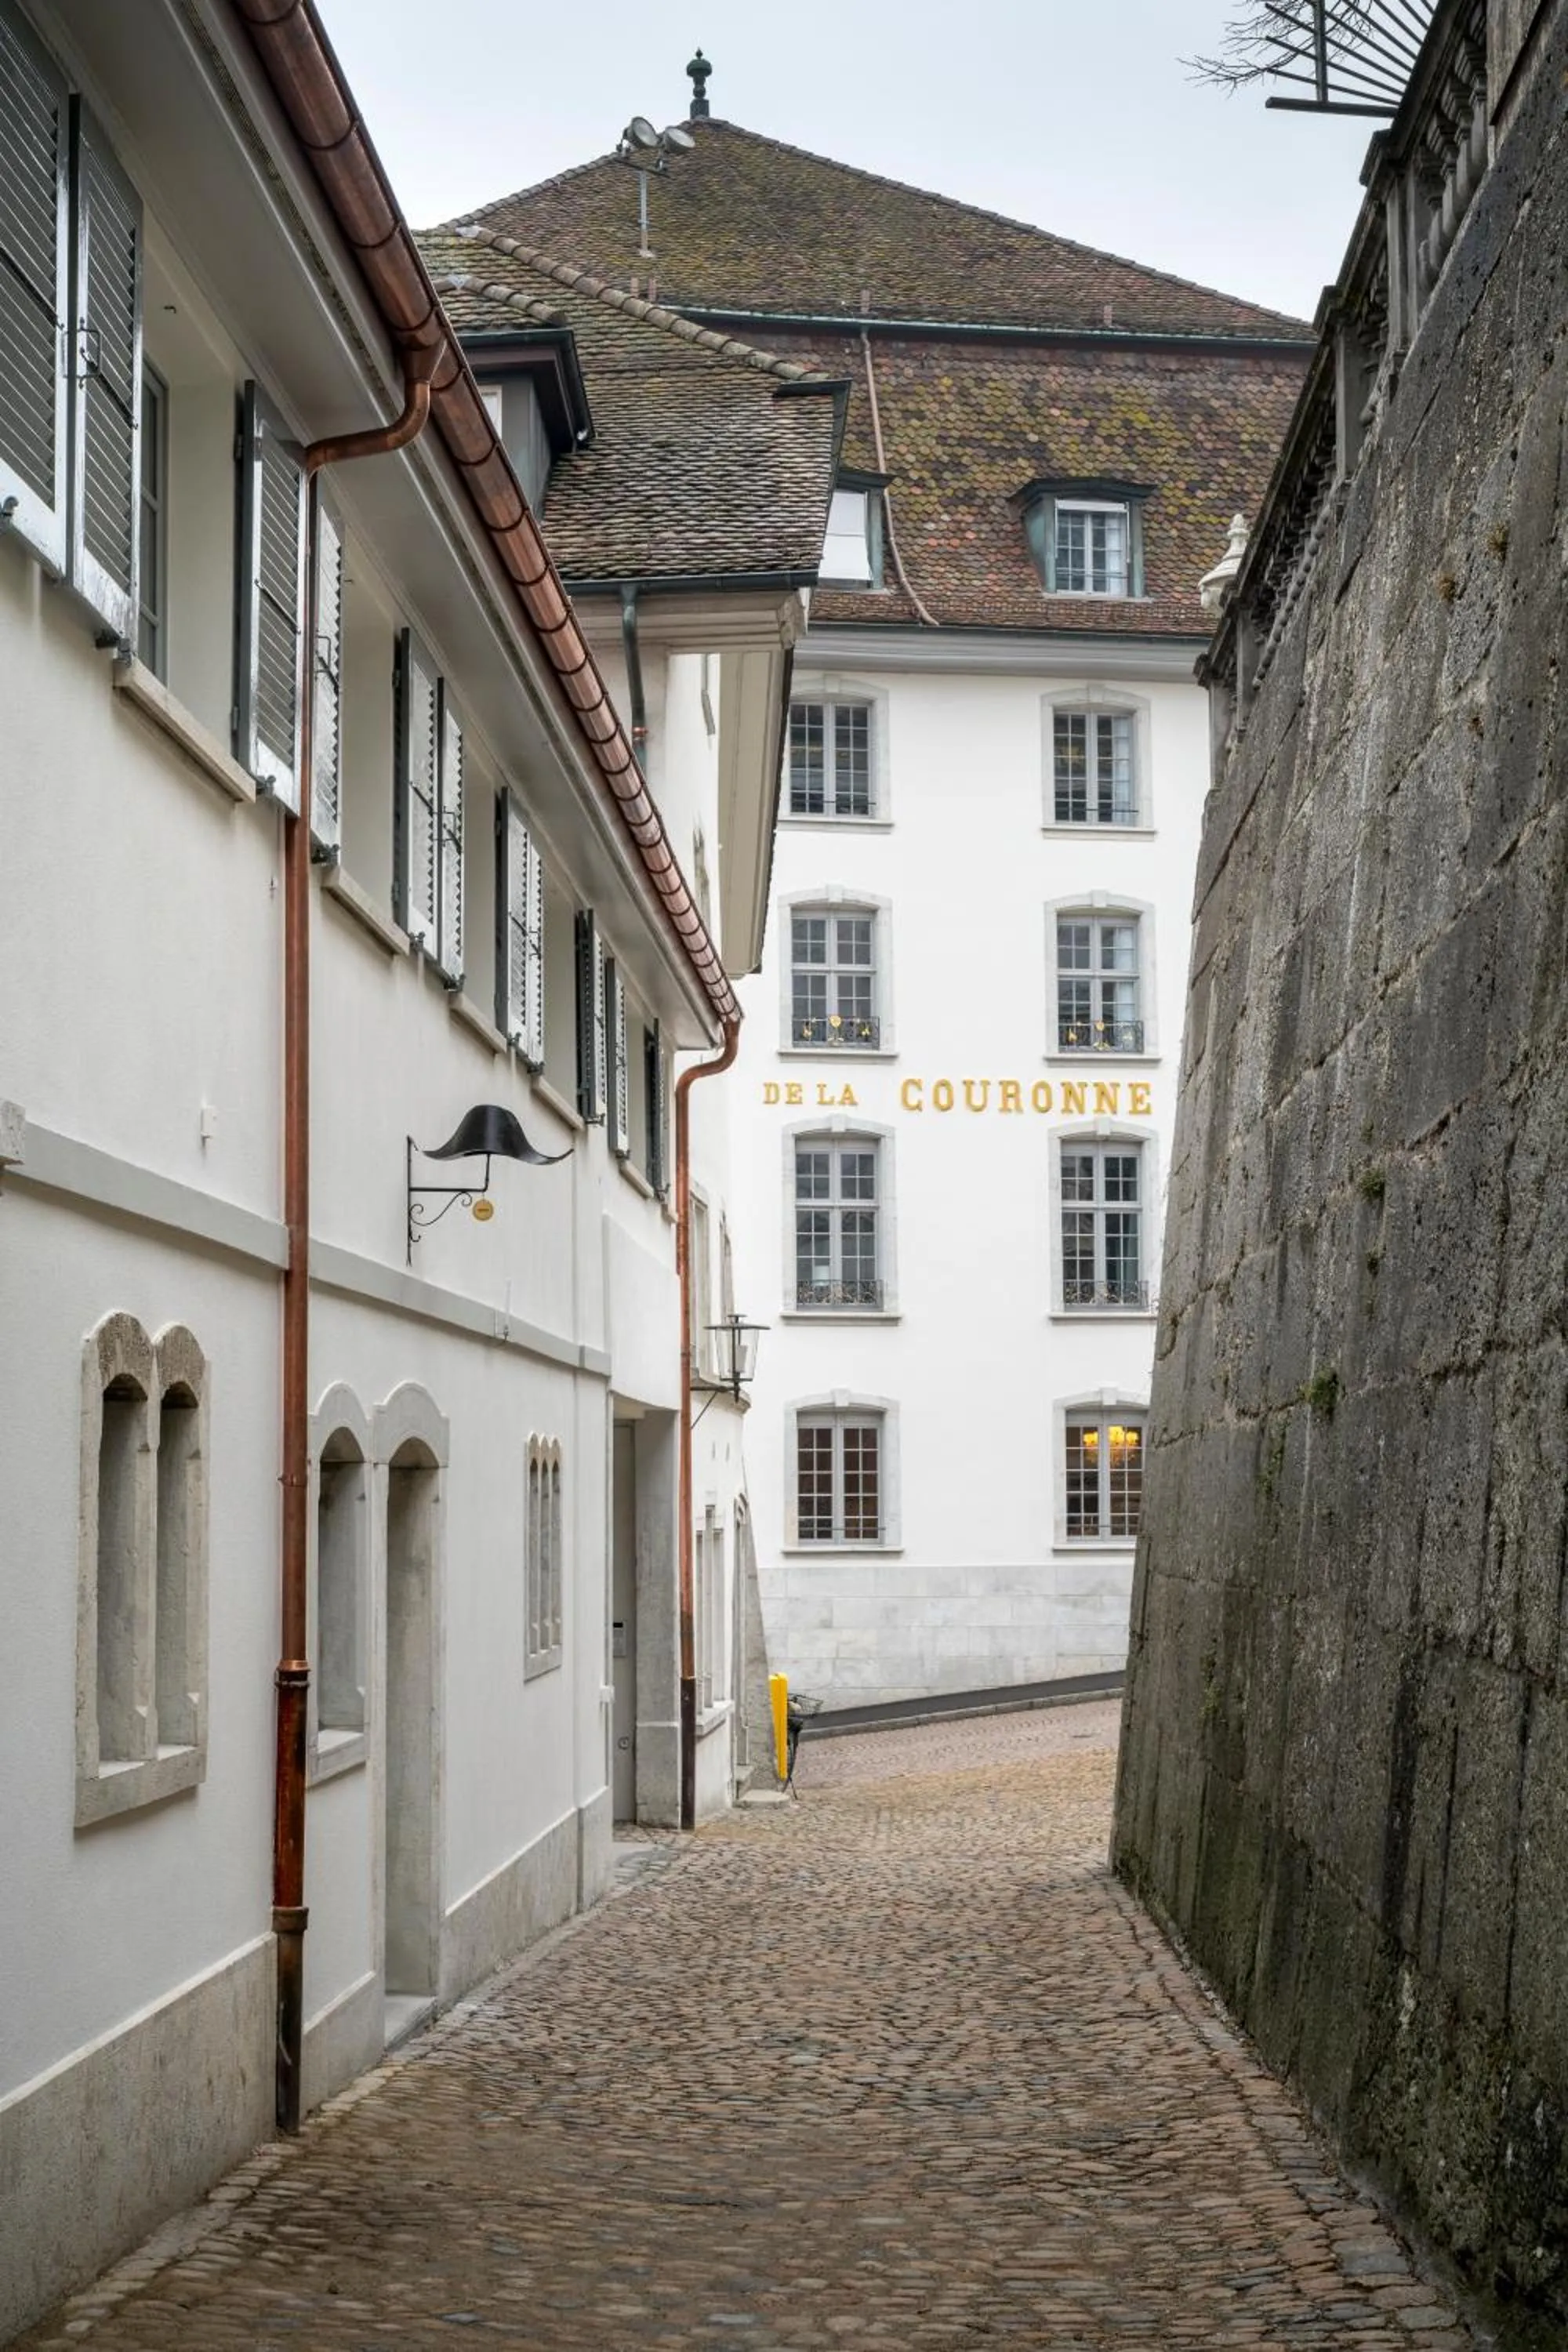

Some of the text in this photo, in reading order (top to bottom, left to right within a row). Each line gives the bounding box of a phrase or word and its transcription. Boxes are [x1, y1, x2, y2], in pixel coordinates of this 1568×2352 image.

[763, 1078, 1152, 1115] DE LA COURONNE
